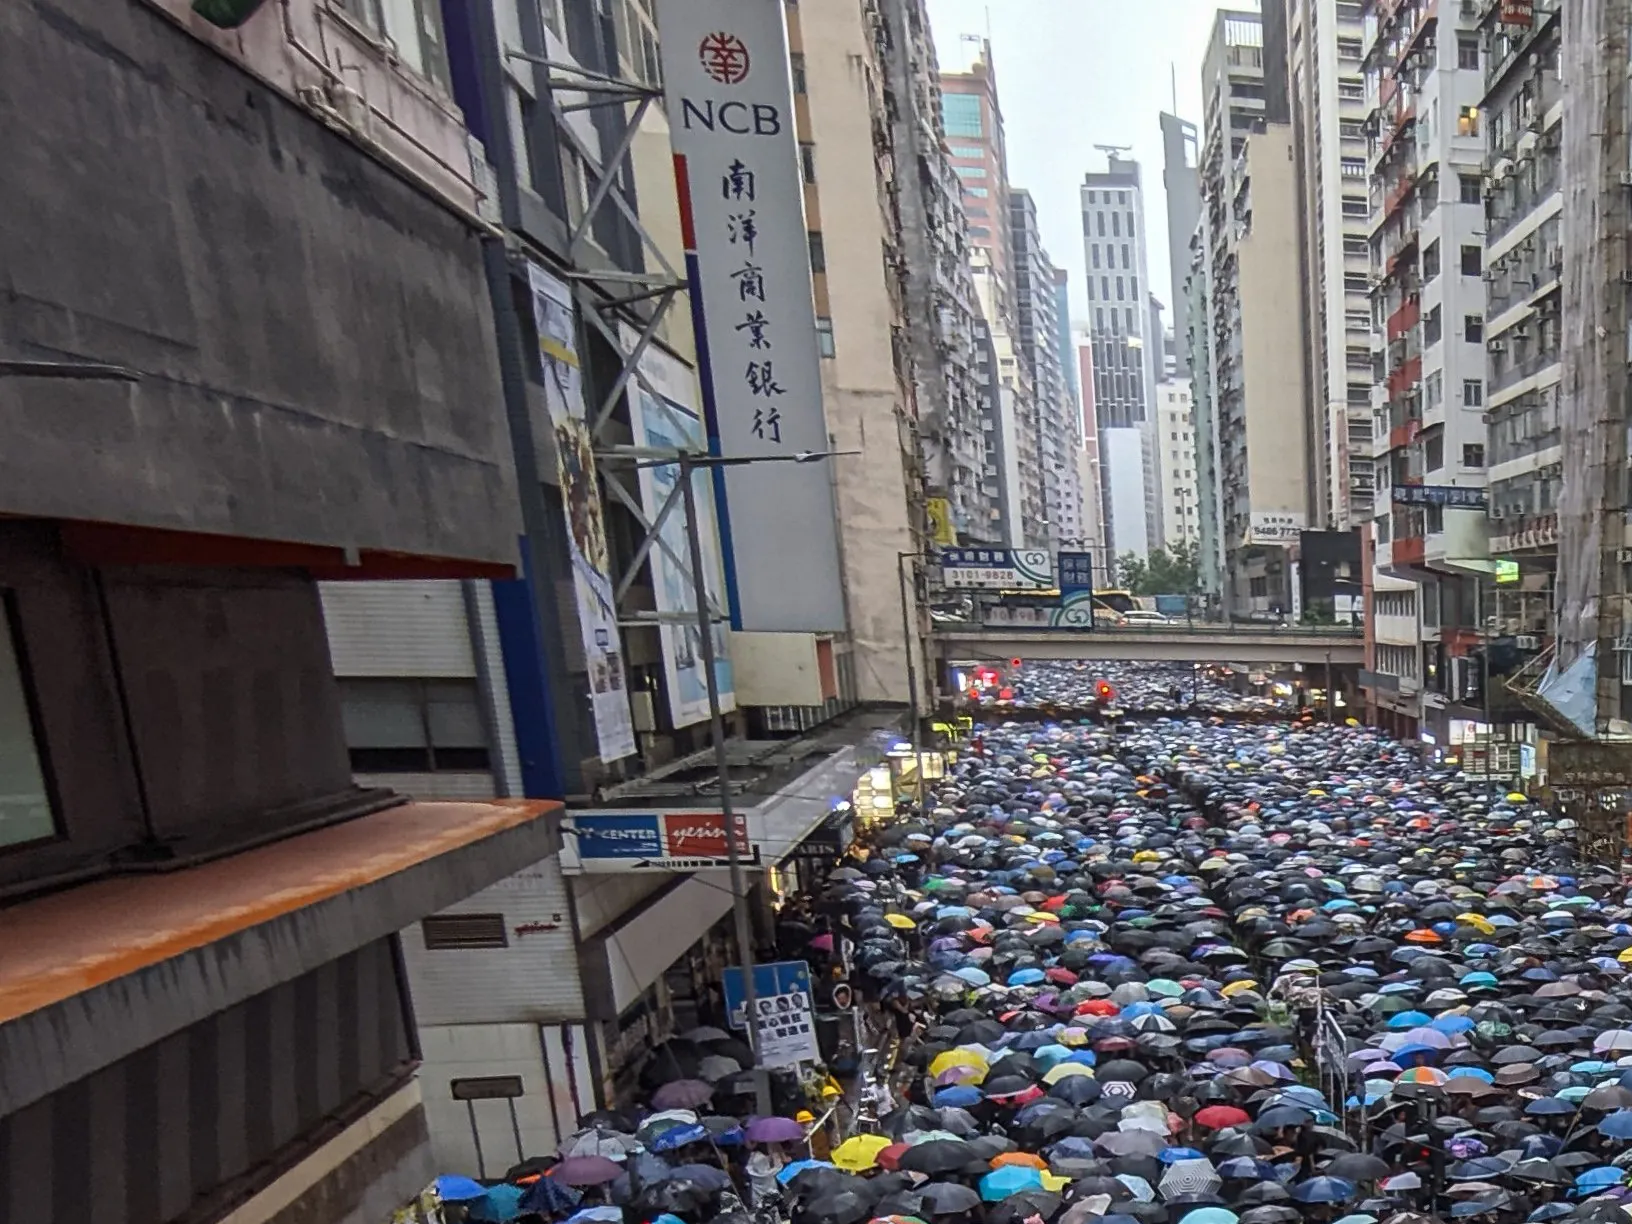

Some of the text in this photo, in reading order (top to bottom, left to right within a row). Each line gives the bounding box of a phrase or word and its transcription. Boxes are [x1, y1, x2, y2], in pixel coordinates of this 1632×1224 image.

[682, 98, 781, 137] NCB
[721, 158, 788, 445] 南洋商業銀行
[795, 843, 836, 855] ARIS
